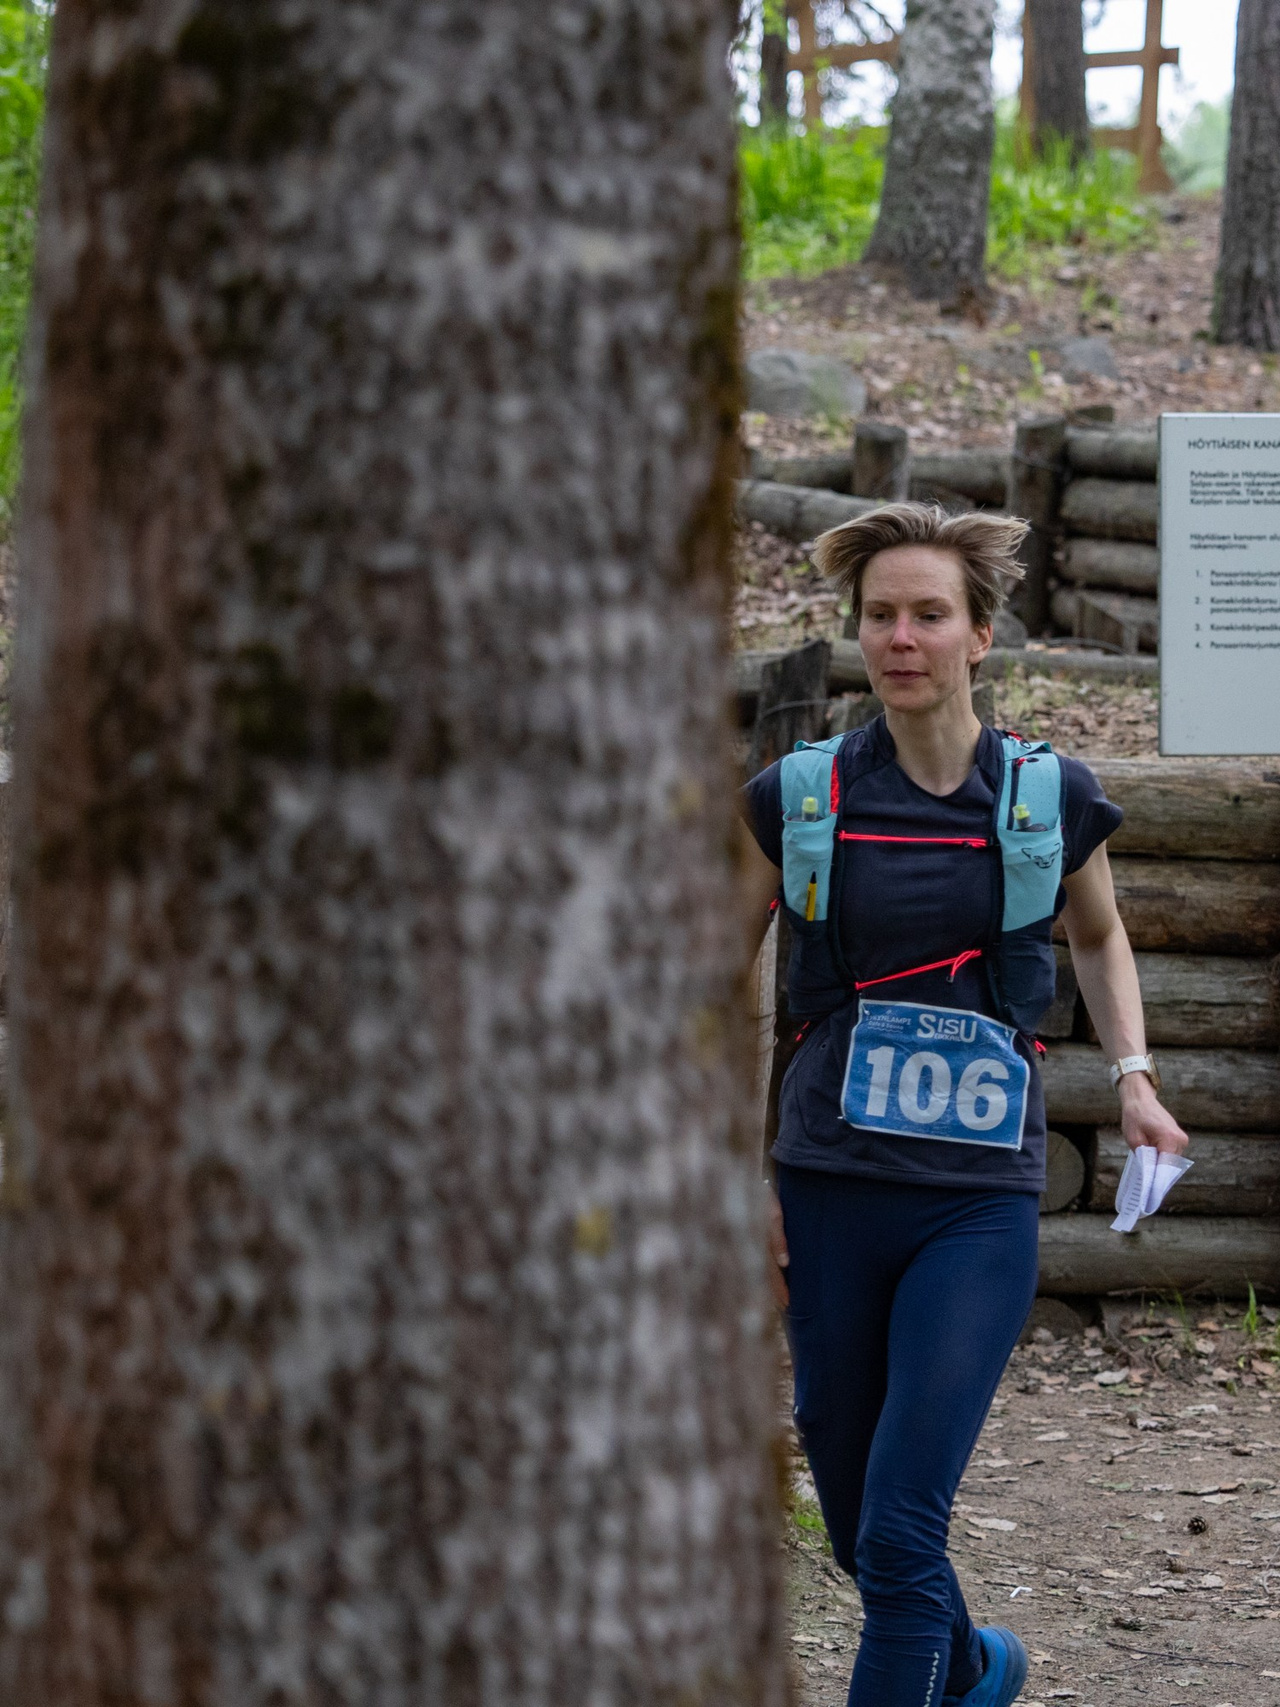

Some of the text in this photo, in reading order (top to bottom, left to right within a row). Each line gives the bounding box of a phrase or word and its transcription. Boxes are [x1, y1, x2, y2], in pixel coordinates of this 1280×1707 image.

[1188, 439, 1250, 450] HÖYTIÄISEN
[916, 1013, 978, 1043] SISU
[865, 1045, 1010, 1131] 106
